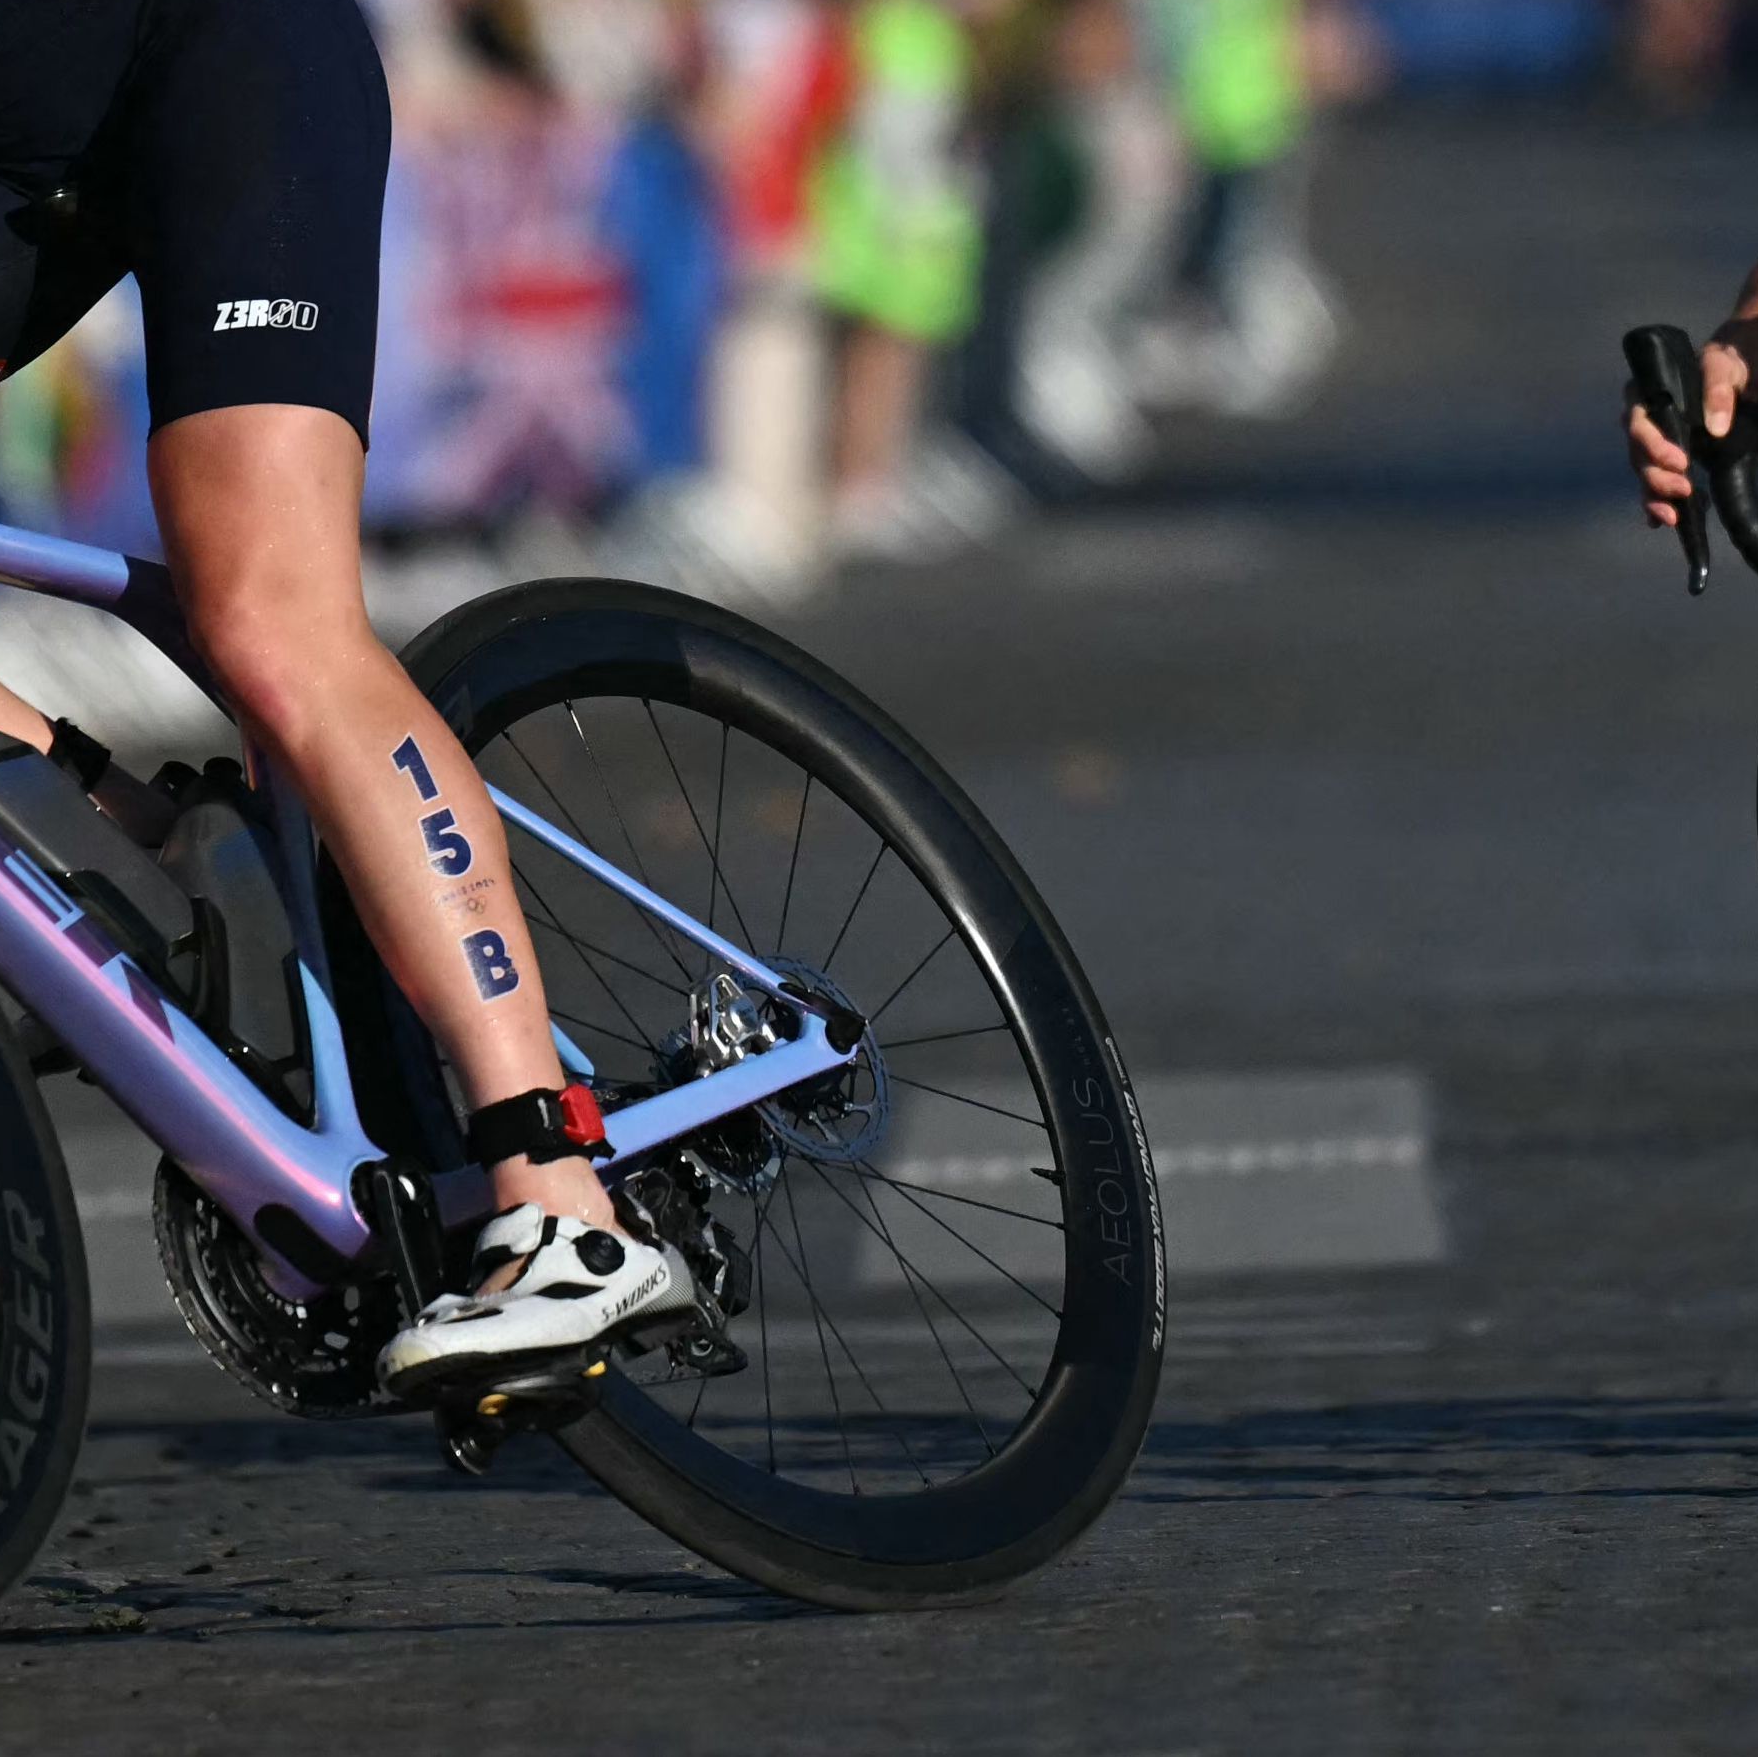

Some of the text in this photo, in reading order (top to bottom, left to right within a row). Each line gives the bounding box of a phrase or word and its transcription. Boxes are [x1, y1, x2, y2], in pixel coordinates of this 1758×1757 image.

[459, 928, 521, 1003] B
[1073, 1076, 1133, 1288] AEOLUS
[601, 1262, 667, 1324] S-WORKS
